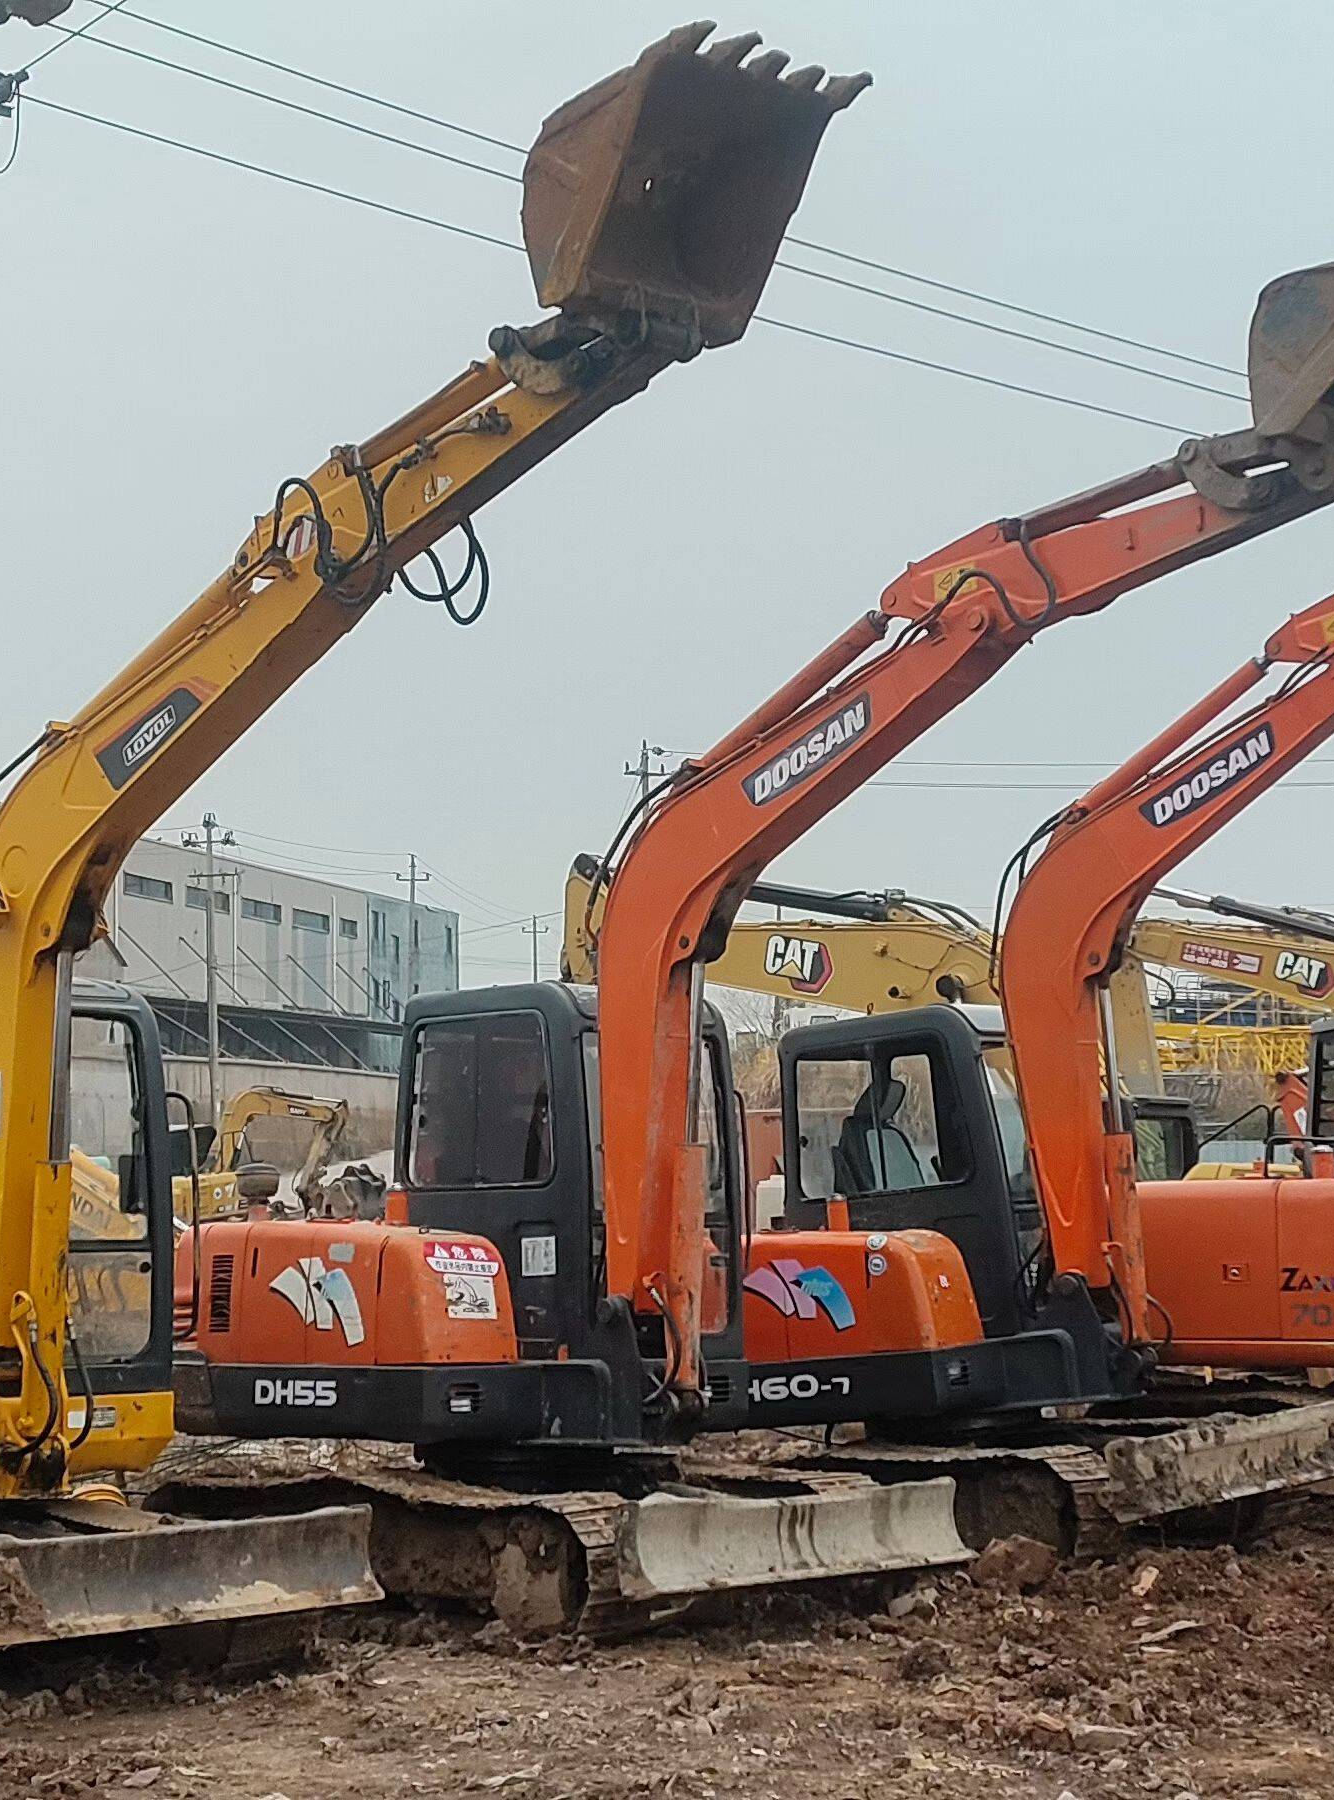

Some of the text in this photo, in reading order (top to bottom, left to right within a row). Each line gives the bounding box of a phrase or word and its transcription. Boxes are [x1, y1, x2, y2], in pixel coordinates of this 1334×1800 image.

[125, 709, 174, 762] LOVOL
[754, 701, 865, 805] DOOSAN
[1152, 729, 1271, 825] DOOSAN
[765, 935, 820, 982] CAT
[1275, 950, 1326, 989] CAT
[1290, 1304, 1334, 1327] 70
[254, 1379, 338, 1407] DH55
